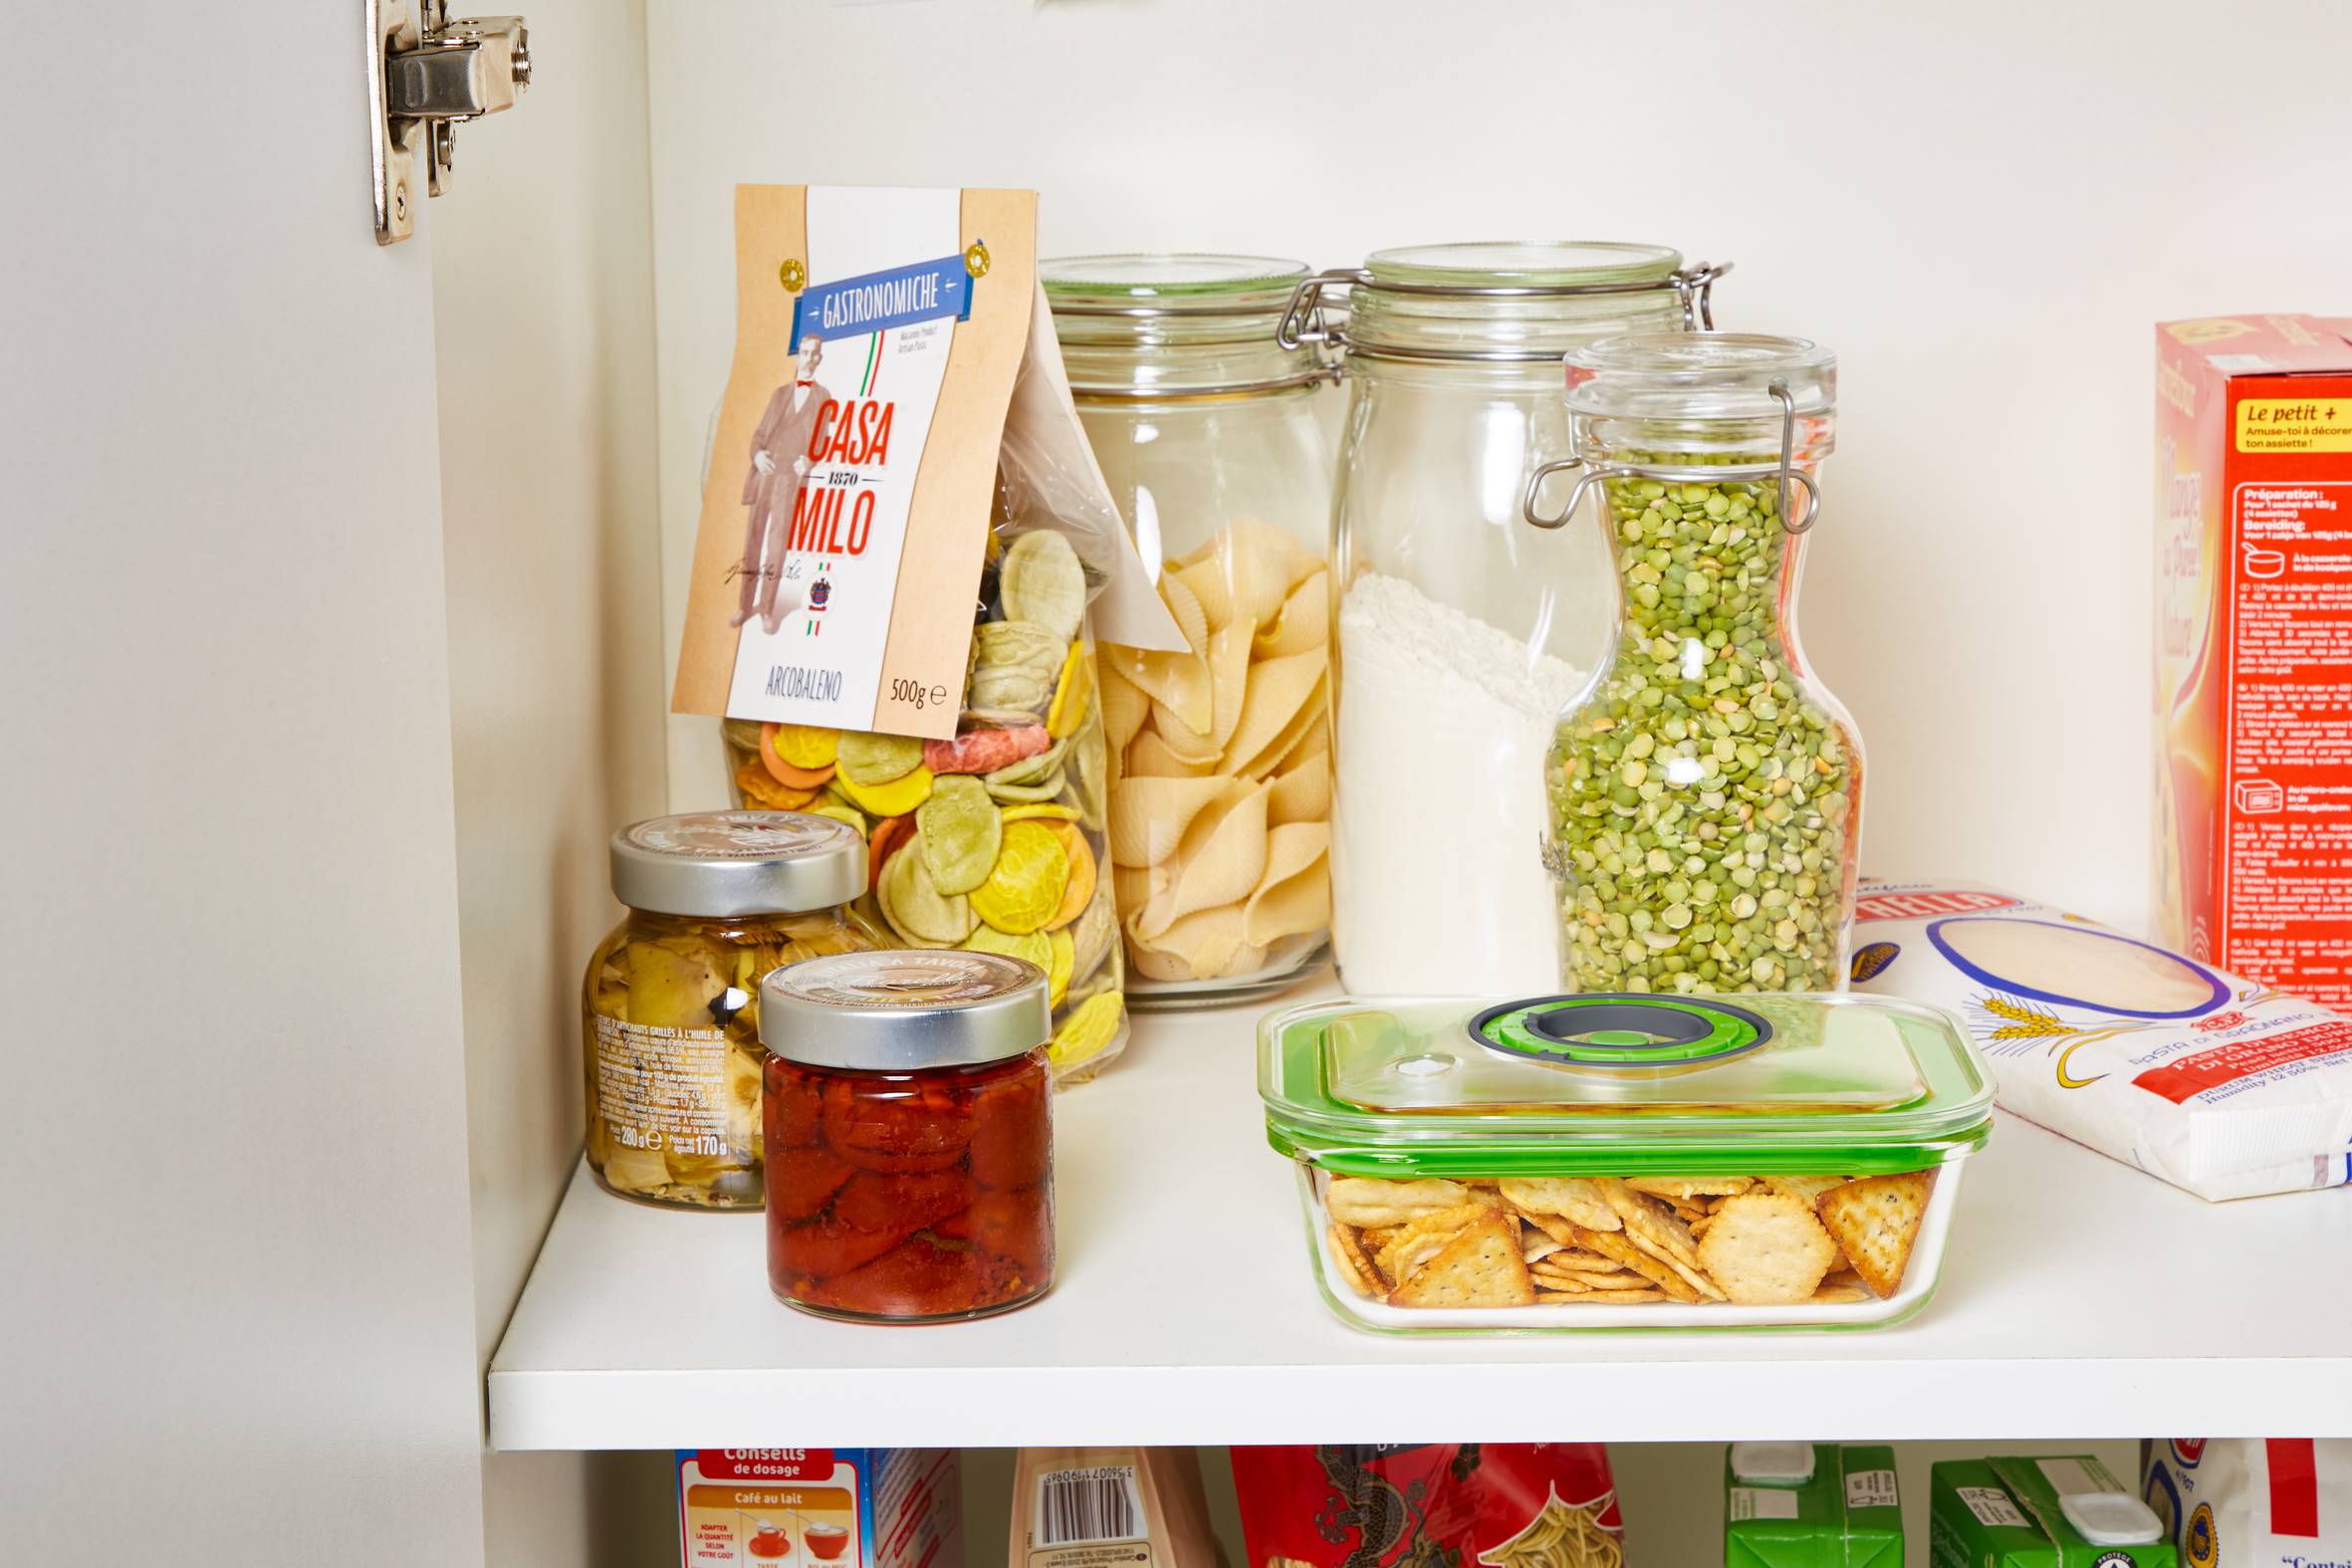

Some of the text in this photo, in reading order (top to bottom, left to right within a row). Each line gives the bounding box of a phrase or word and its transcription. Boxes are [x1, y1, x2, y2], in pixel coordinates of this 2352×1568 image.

[823, 272, 939, 330] GASTRONOMICHE
[2247, 406, 2267, 421] Le
[2273, 405, 2318, 423] petit
[808, 398, 895, 466] CASA
[826, 471, 858, 487] 1870
[2244, 489, 2318, 500] Préparation
[2244, 501, 2264, 510] Pour
[787, 487, 876, 557] MILO
[2243, 520, 2305, 532] Bereiding:
[765, 666, 843, 702] ARCOBALENO
[1856, 893, 2000, 918] AELLA
[649, 1025, 676, 1037] GRILLÉS
[677, 1027, 682, 1038] À
[685, 1029, 711, 1039] L'HUILE
[715, 1030, 724, 1039] DE
[2172, 1042, 2239, 1071] PASTA
[2241, 1035, 2265, 1049] DI
[2198, 1058, 2222, 1071] DI
[2226, 1039, 2299, 1062] GRANO
[2229, 1055, 2265, 1070] Peso
[2197, 1077, 2252, 1100] DURUM
[2256, 1060, 2305, 1078] WHEAT
[2205, 1079, 2266, 1105] Humidity
[621, 1126, 637, 1147] 280
[696, 1136, 718, 1155] 170
[719, 1142, 728, 1155] g
[733, 1463, 801, 1477] de dosage
[735, 1492, 803, 1504] Café au lait
[700, 1523, 728, 1532] ADAPTER
